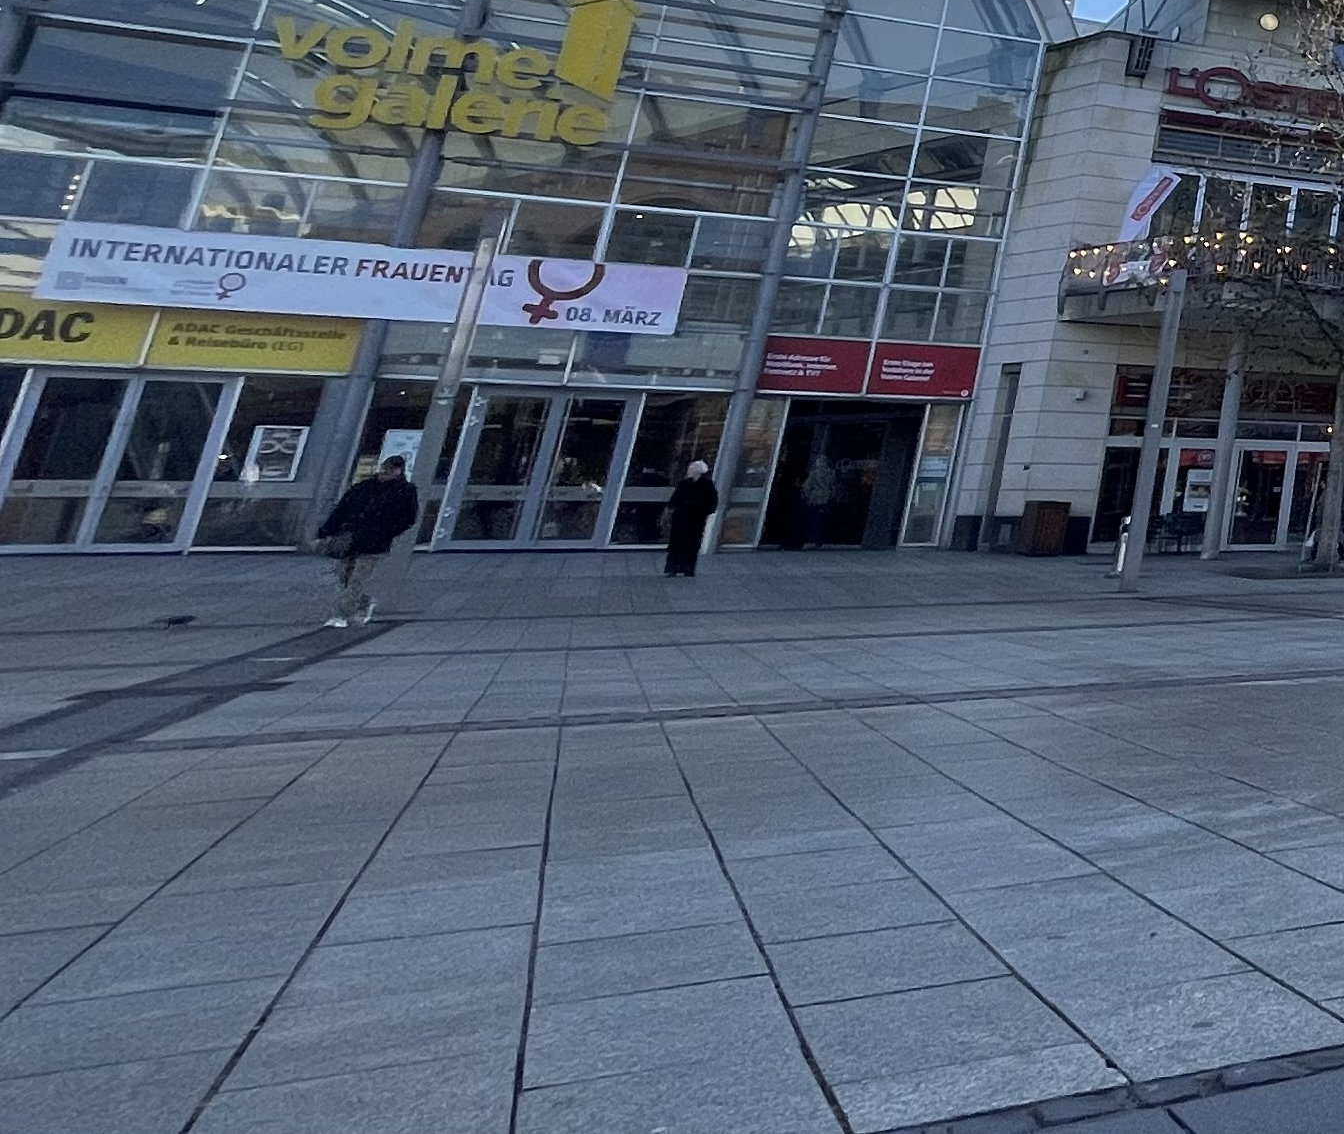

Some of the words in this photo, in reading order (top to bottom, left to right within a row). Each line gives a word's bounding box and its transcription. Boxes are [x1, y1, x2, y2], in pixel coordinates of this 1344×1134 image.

[275, 13, 552, 89] volme
[308, 73, 607, 145] galerie
[67, 238, 349, 276] INTERNATIONALER
[355, 258, 515, 287] FRAUENG
[172, 323, 221, 335] ADAC
[565, 306, 597, 323] 08.
[603, 306, 661, 326] MÄRZ
[168, 336, 179, 346] &
